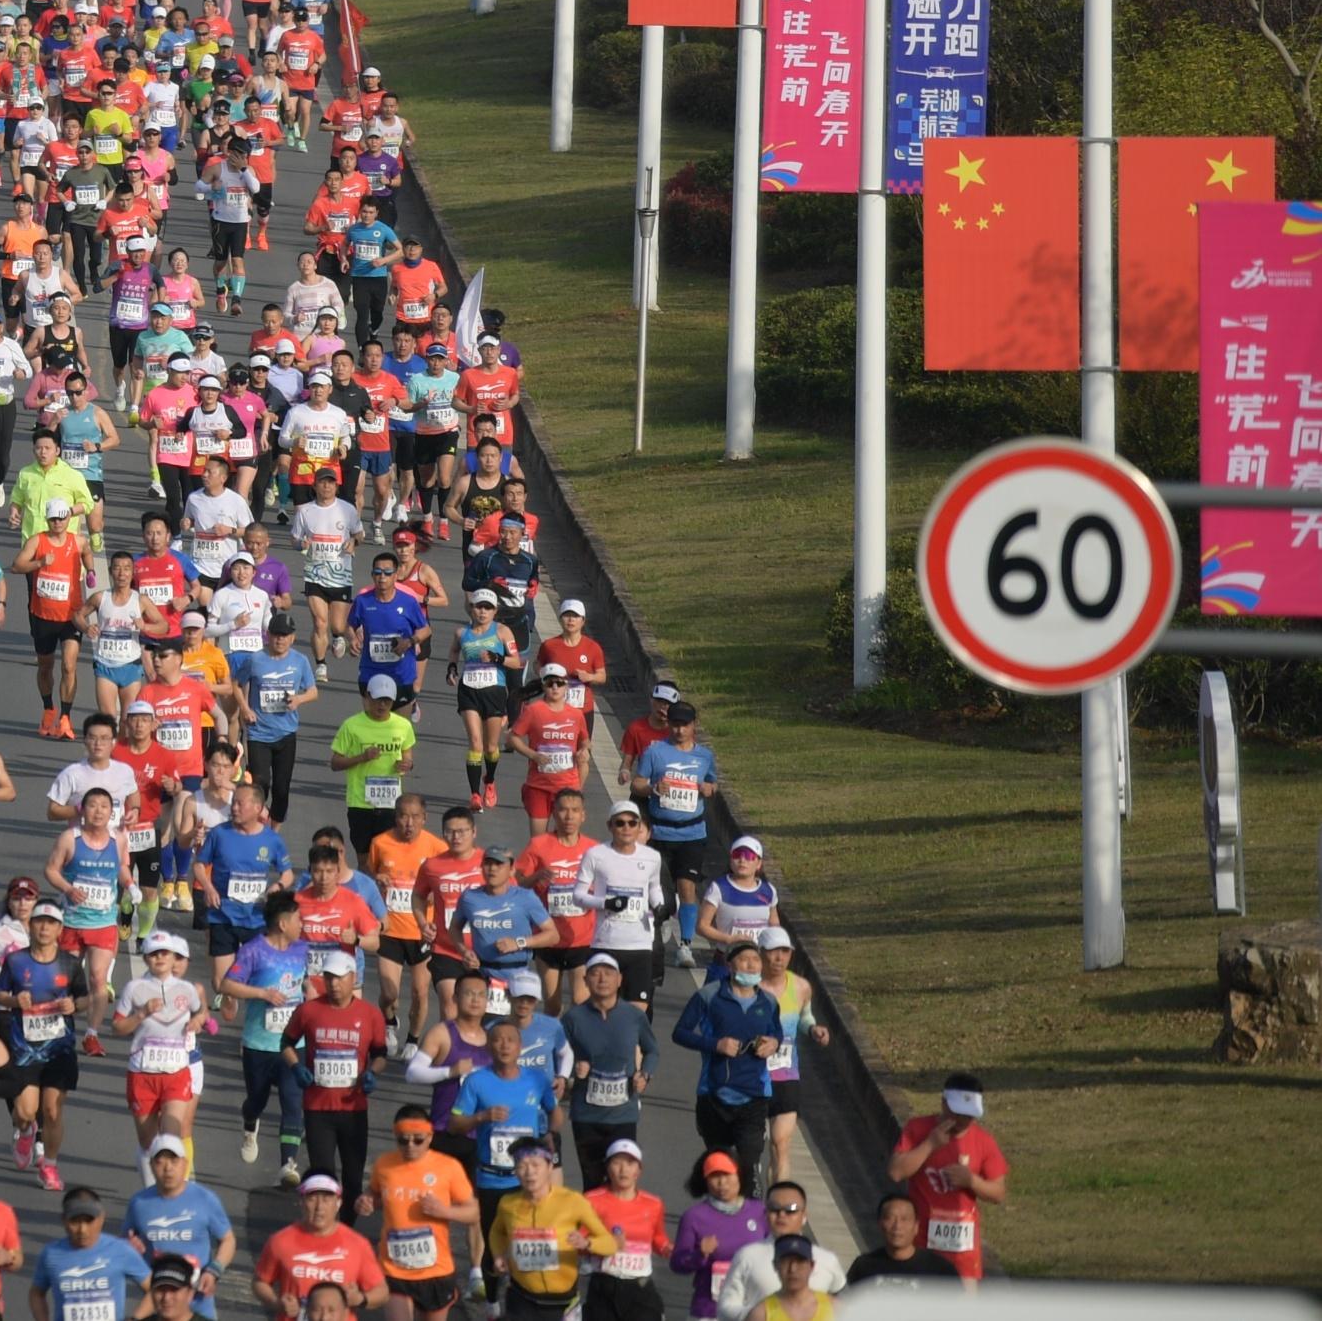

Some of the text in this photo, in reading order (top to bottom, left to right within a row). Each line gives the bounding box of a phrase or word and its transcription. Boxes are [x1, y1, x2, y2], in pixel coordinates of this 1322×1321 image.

[903, 23, 979, 57] 开跑
[814, 31, 852, 147] 飞向春天
[919, 88, 960, 113] 芜湖
[918, 114, 959, 139] 航空
[476, 392, 505, 400] ERKE
[196, 541, 219, 551] A0495
[987, 510, 1124, 621] 60
[41, 582, 66, 593] A1044
[158, 705, 189, 715] ERKE
[542, 731, 574, 740] ERKE
[129, 832, 151, 842] 0879
[553, 870, 577, 878] ERK
[473, 919, 512, 929] ERKE
[304, 925, 341, 935] ERKE
[319, 1062, 353, 1075] B3063
[147, 1230, 192, 1241] ERKE
[935, 1226, 969, 1238] A0071
[292, 1266, 344, 1282] ERKE
[60, 1280, 108, 1291] ERKE
